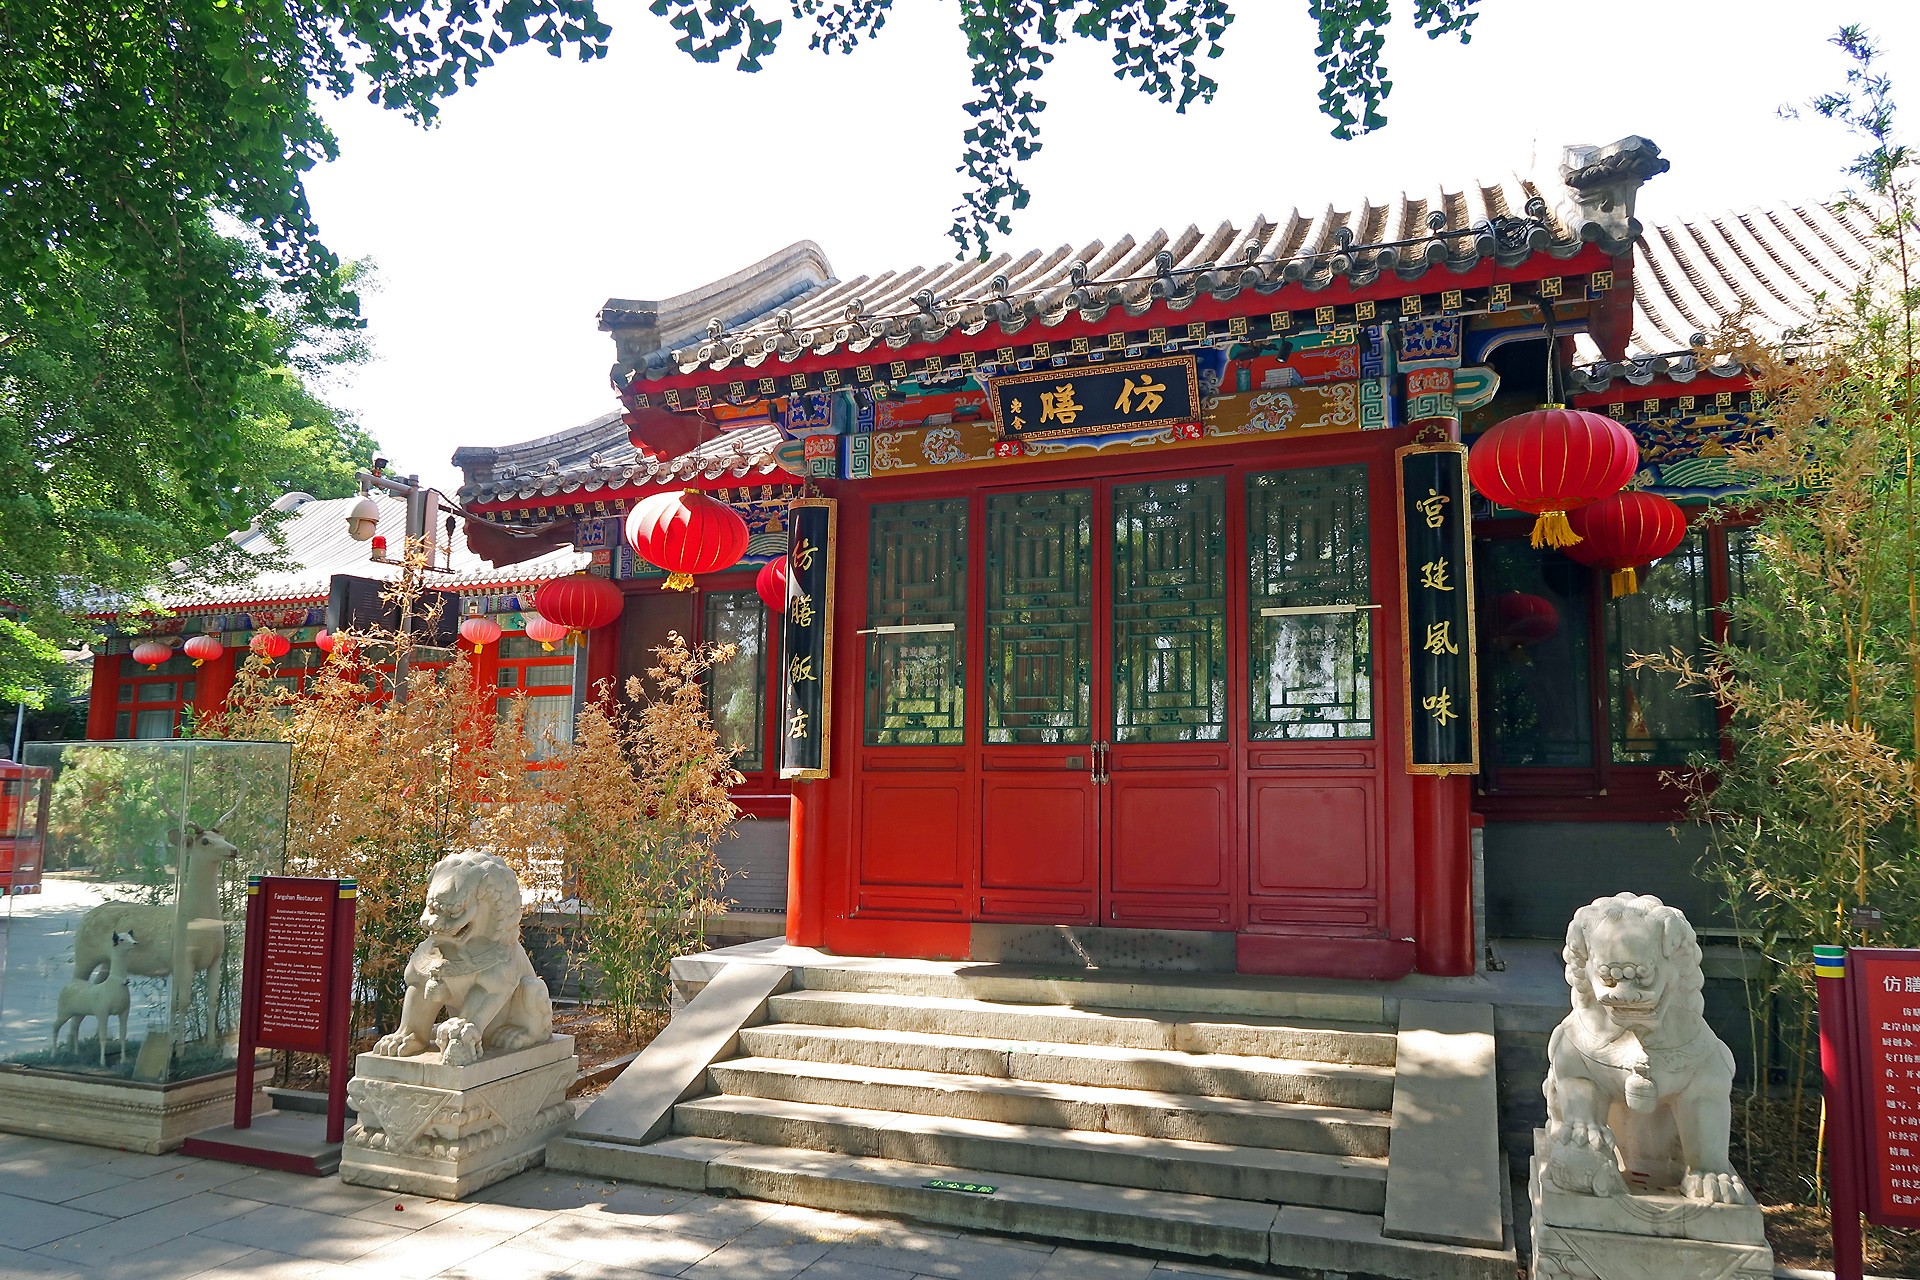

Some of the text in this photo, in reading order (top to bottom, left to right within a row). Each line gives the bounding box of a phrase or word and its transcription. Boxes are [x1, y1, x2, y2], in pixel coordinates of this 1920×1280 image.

[274, 893, 323, 902] Fangshan Restaurant
[1883, 976, 1920, 992] 仿膳
